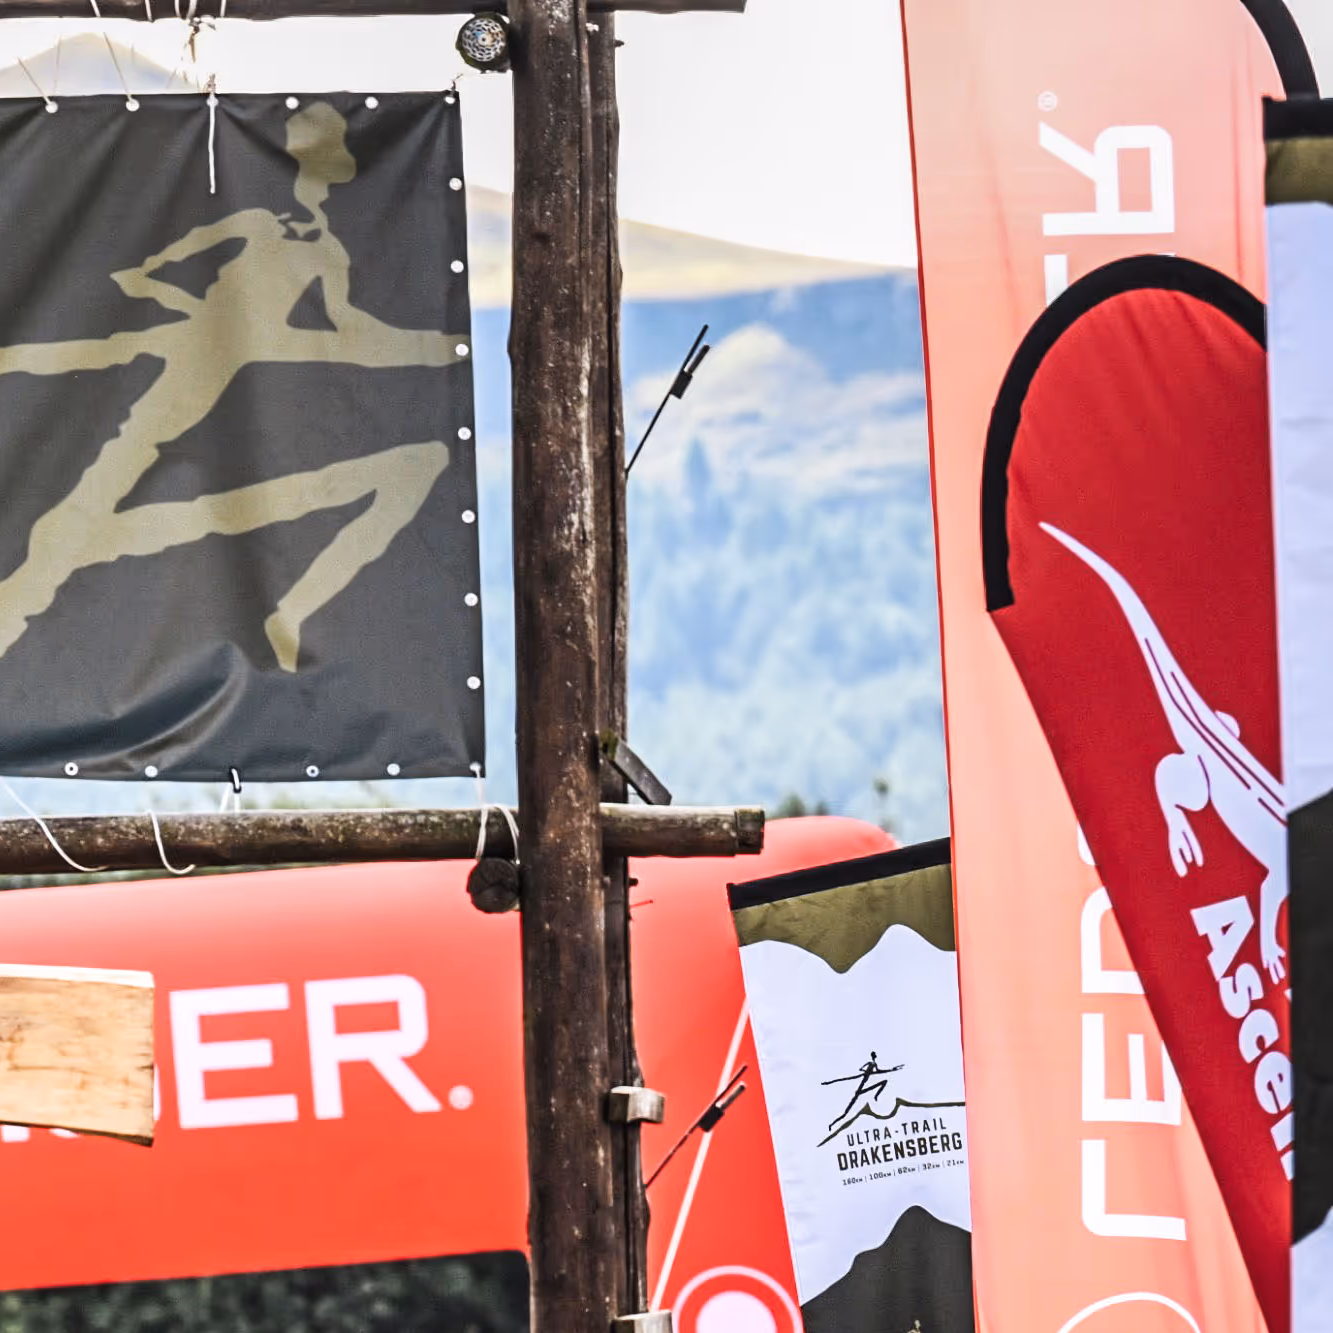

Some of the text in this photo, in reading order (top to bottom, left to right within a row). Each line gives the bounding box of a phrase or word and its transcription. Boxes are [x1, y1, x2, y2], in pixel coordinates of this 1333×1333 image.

[1190, 895, 1294, 1181] Asce
[846, 1117, 947, 1146] ULTRA-TRAIL
[837, 1132, 963, 1171] DRAKENSBERG
